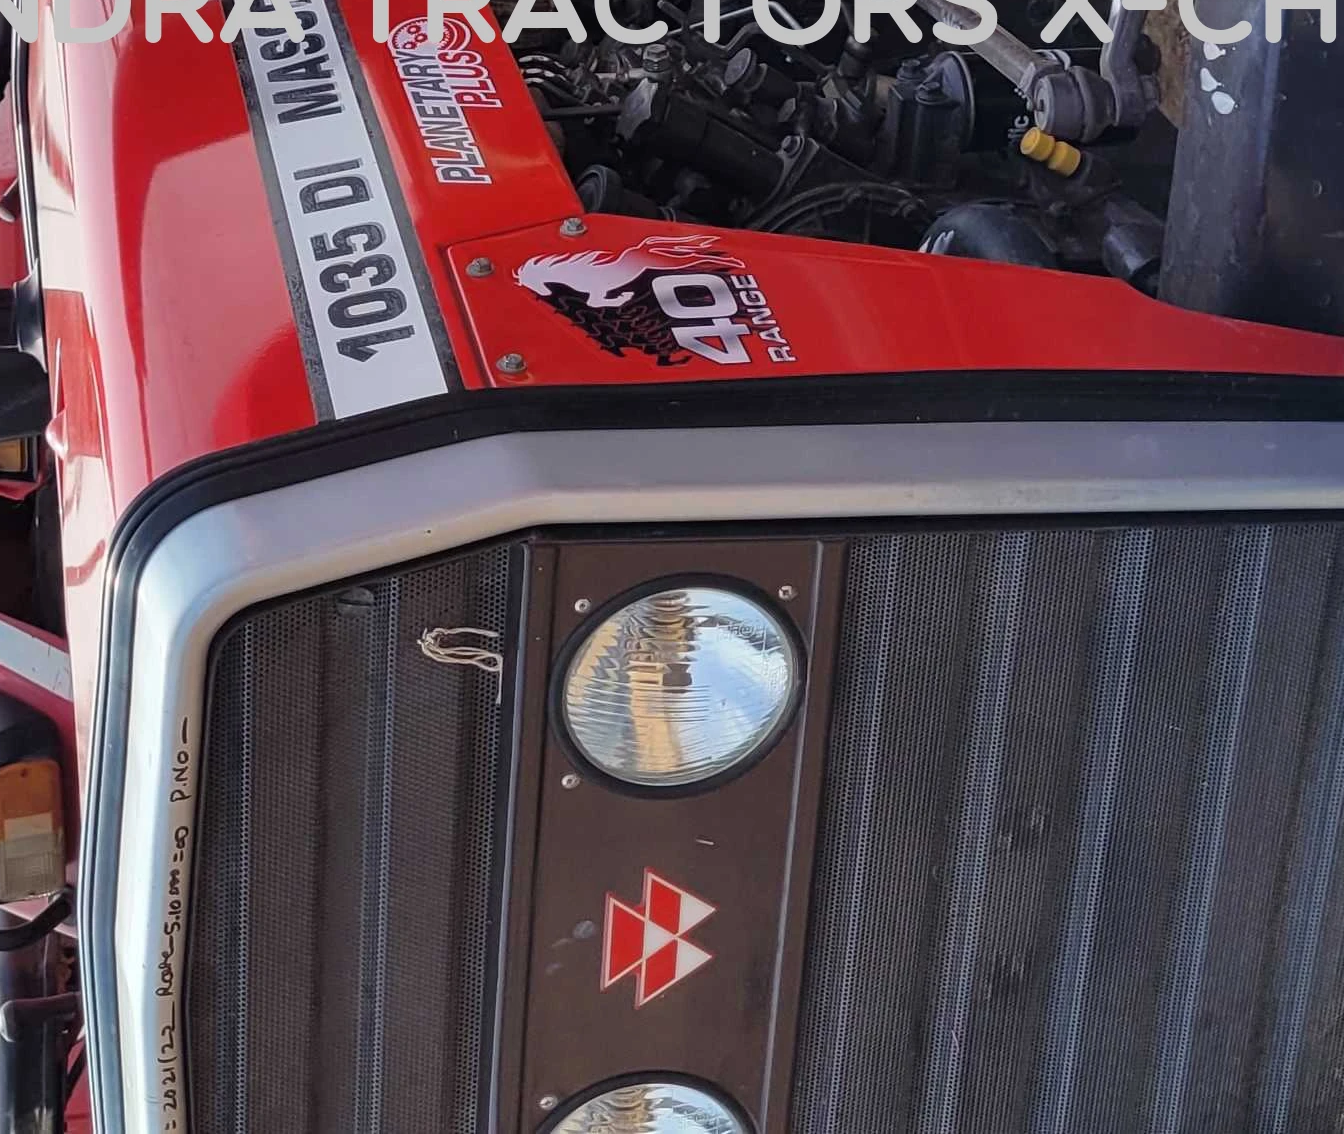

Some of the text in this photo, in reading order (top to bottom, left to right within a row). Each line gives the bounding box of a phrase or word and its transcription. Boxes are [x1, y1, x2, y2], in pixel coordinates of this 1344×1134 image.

[395, 50, 493, 185] PLANETARY
[437, 50, 503, 108] PLUS
[293, 157, 374, 214] DI
[309, 222, 416, 362] 1035
[651, 273, 752, 365] 40
[729, 273, 797, 363] RANGE
